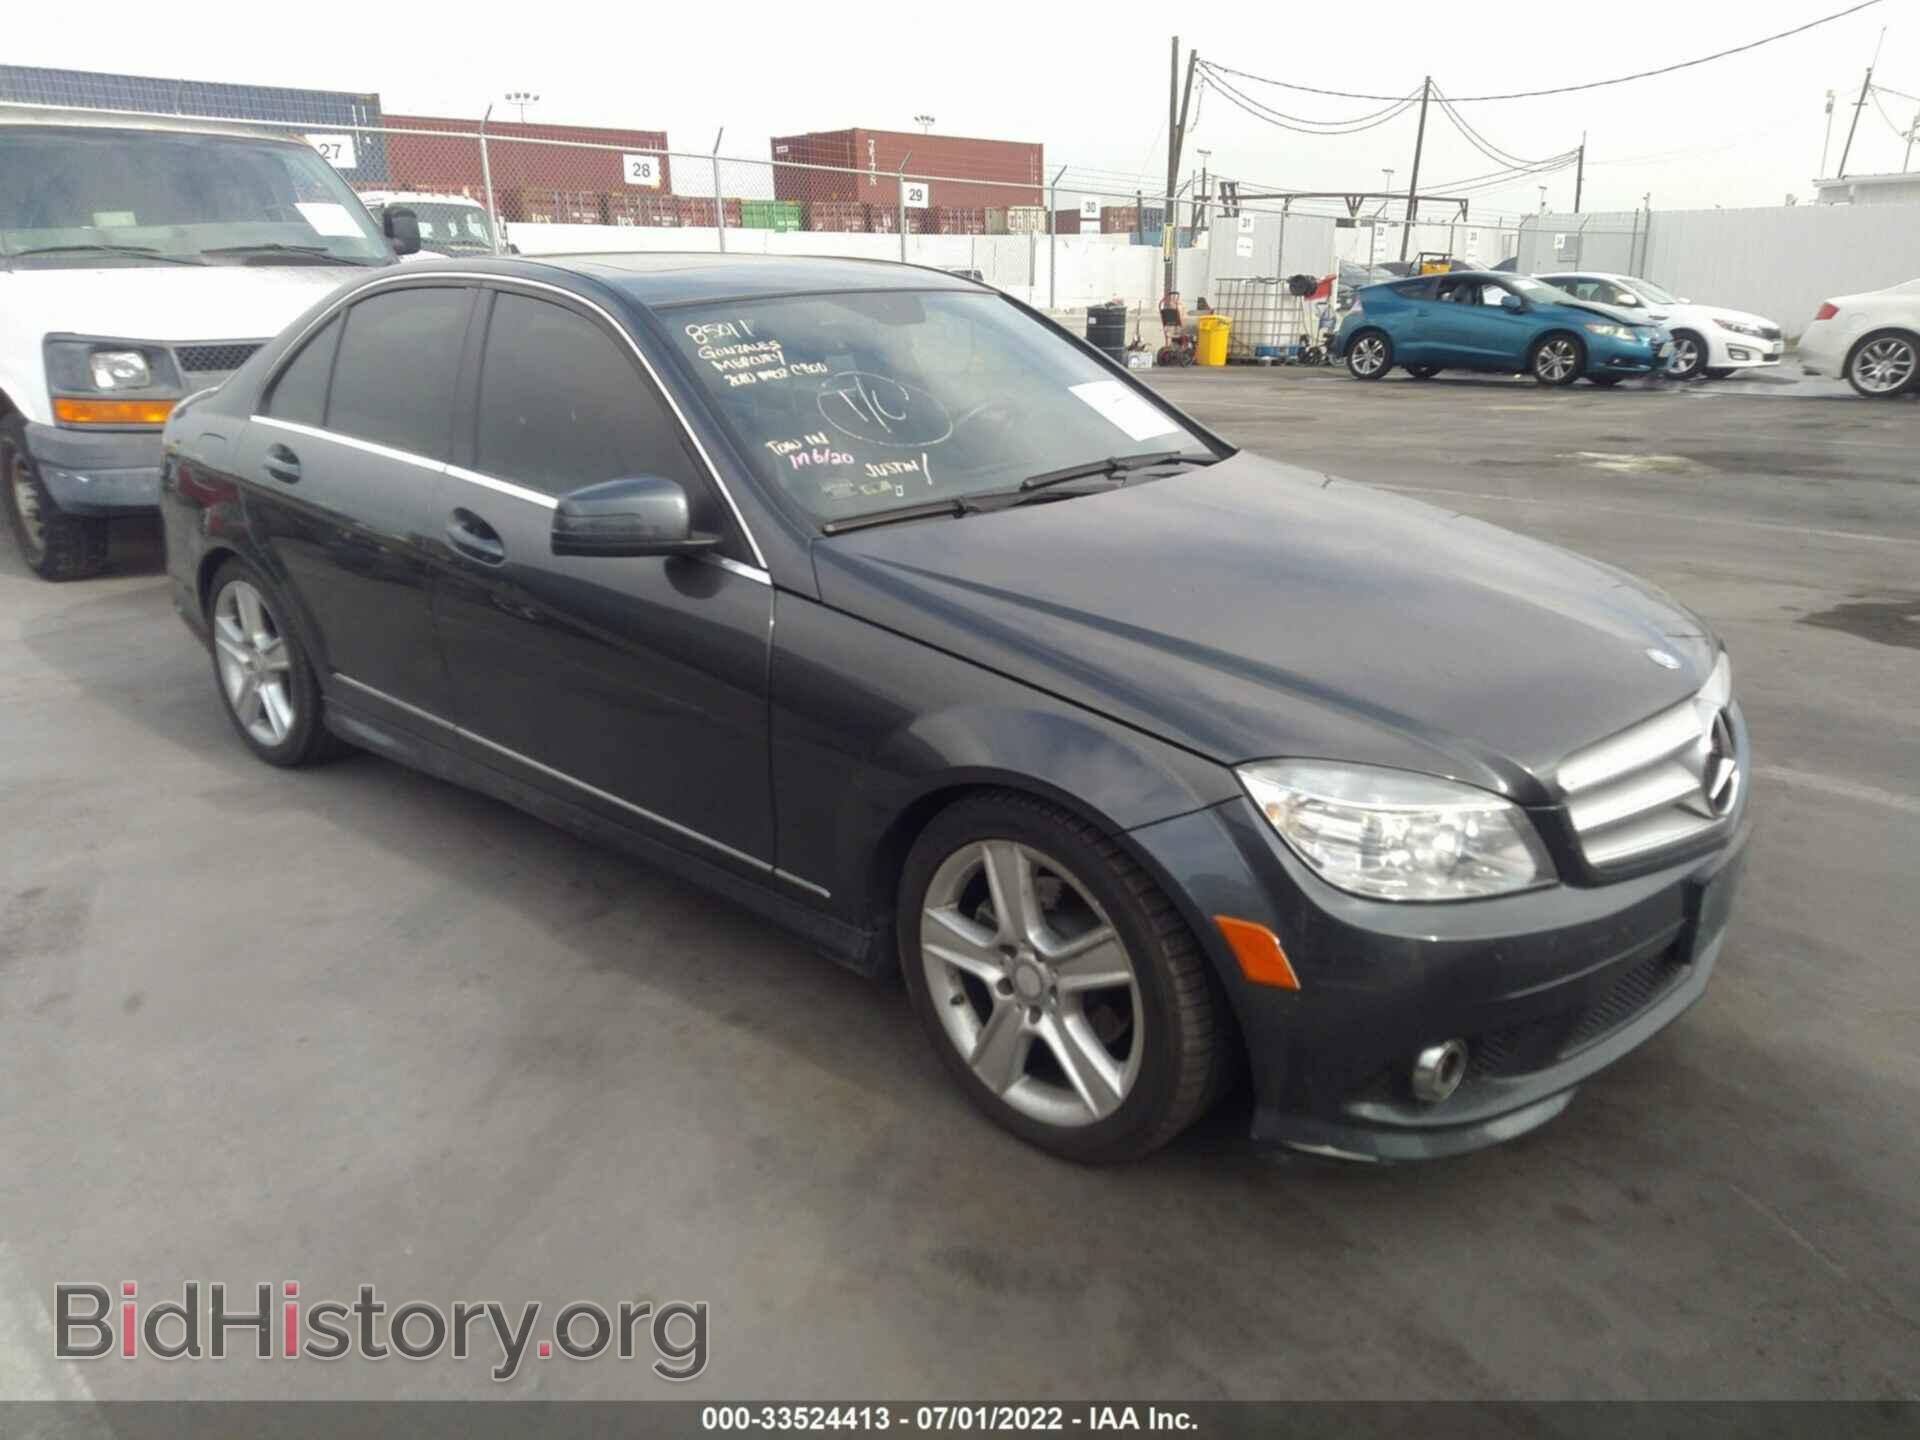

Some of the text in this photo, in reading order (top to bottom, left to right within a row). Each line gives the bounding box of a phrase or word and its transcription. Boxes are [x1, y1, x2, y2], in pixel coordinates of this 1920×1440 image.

[319, 143, 342, 160] 27
[632, 162, 650, 178] 28
[908, 188, 923, 202] 29
